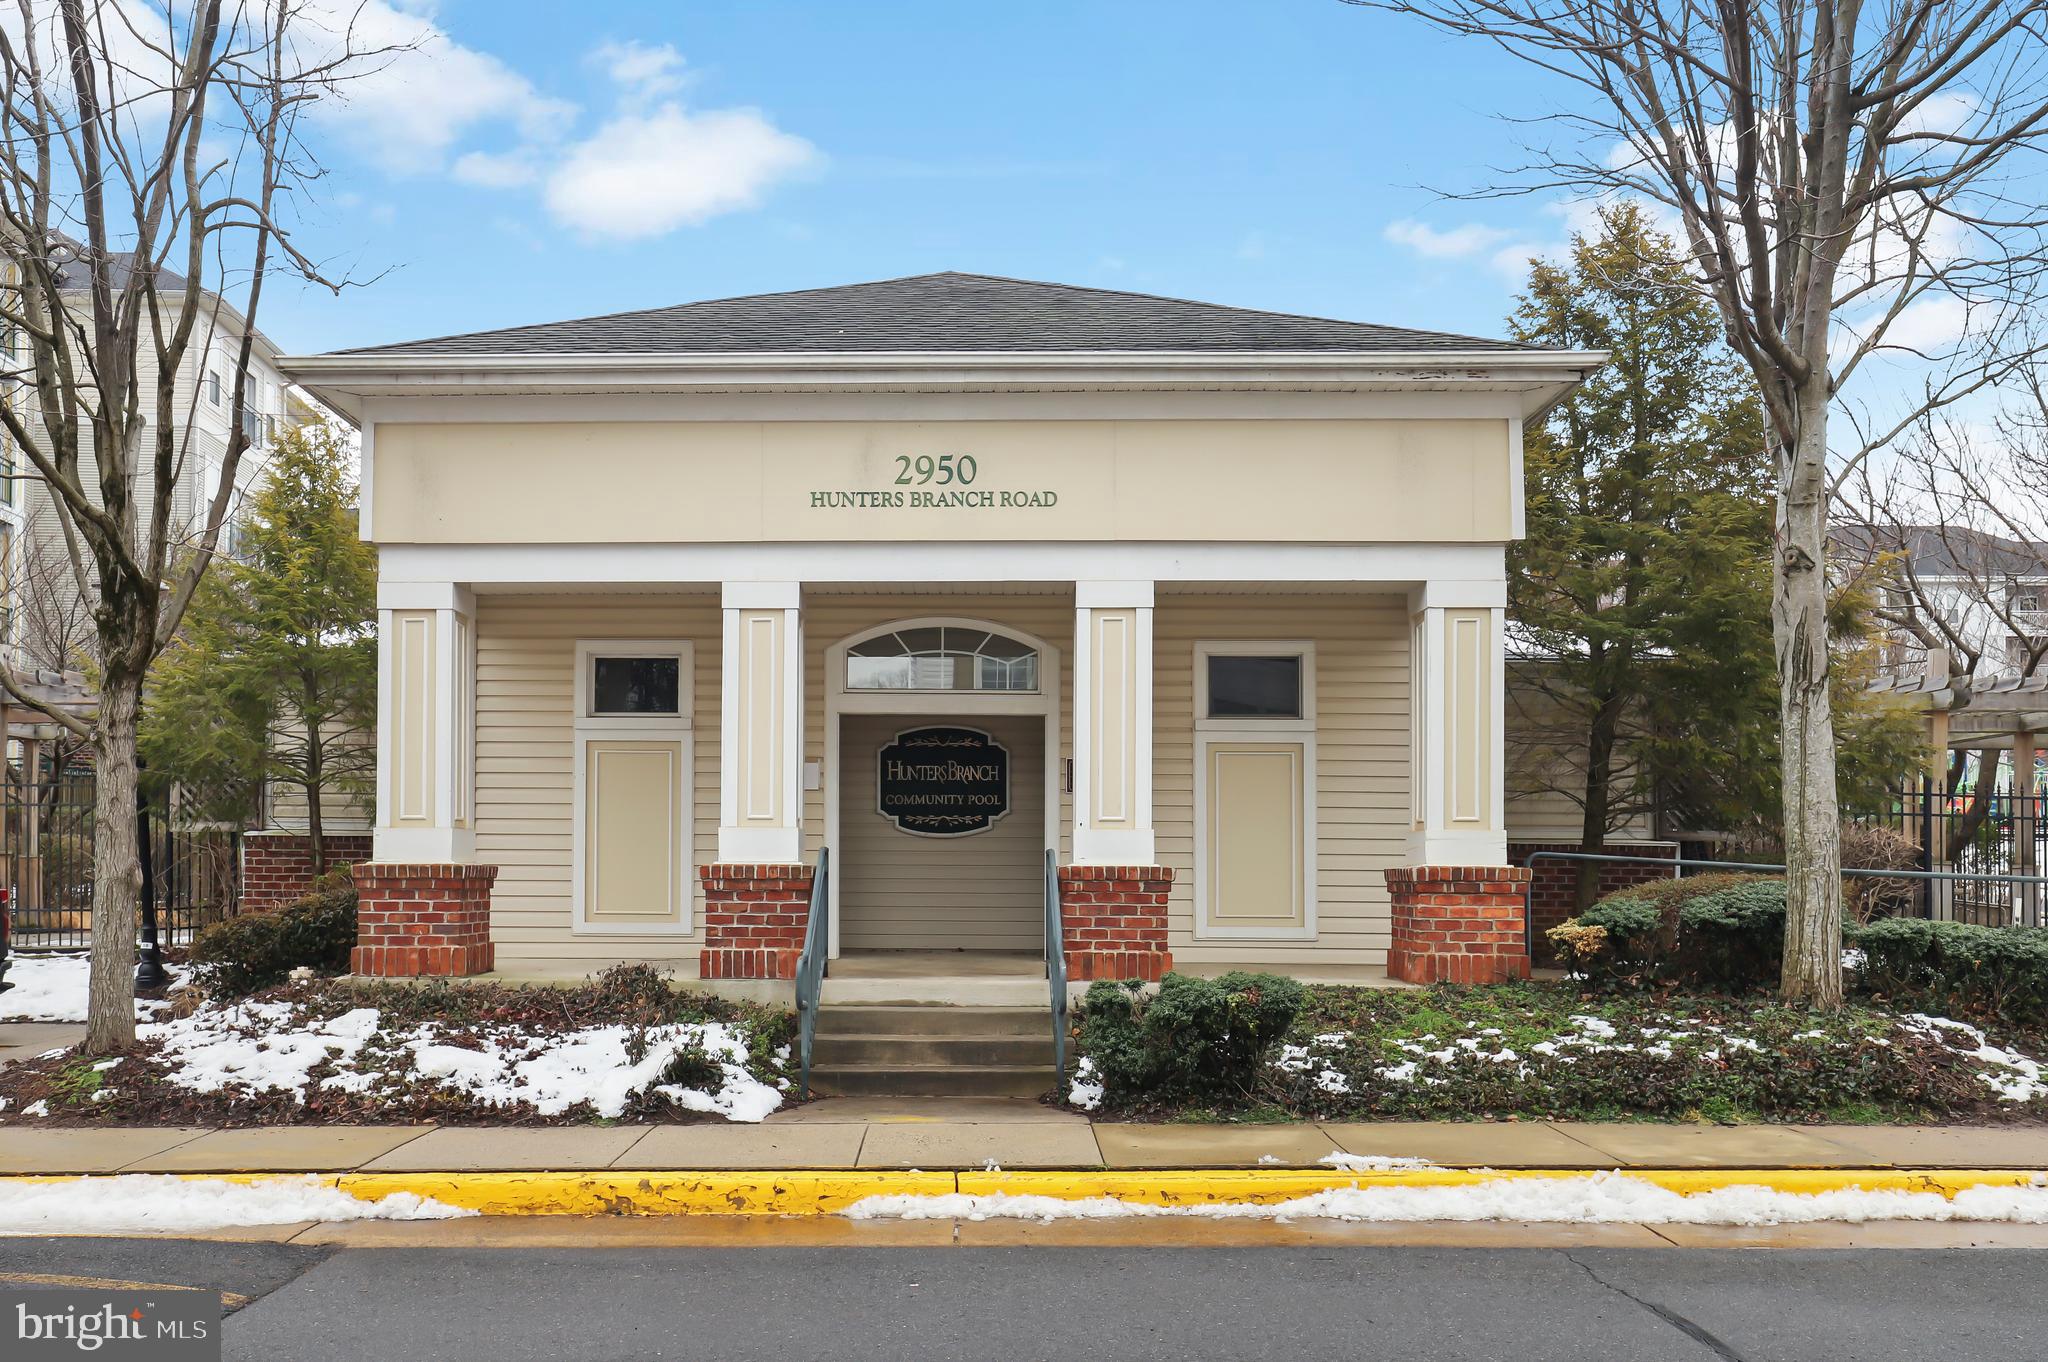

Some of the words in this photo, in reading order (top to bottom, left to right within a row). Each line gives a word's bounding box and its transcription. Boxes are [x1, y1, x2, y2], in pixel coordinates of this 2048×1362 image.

[894, 454, 977, 485] 2950
[810, 491, 904, 507] HUNTERS
[909, 491, 995, 507] BRANCH
[999, 491, 1058, 507] ROAD
[886, 794, 964, 805] COMMUNITY
[968, 794, 1001, 805] POOL
